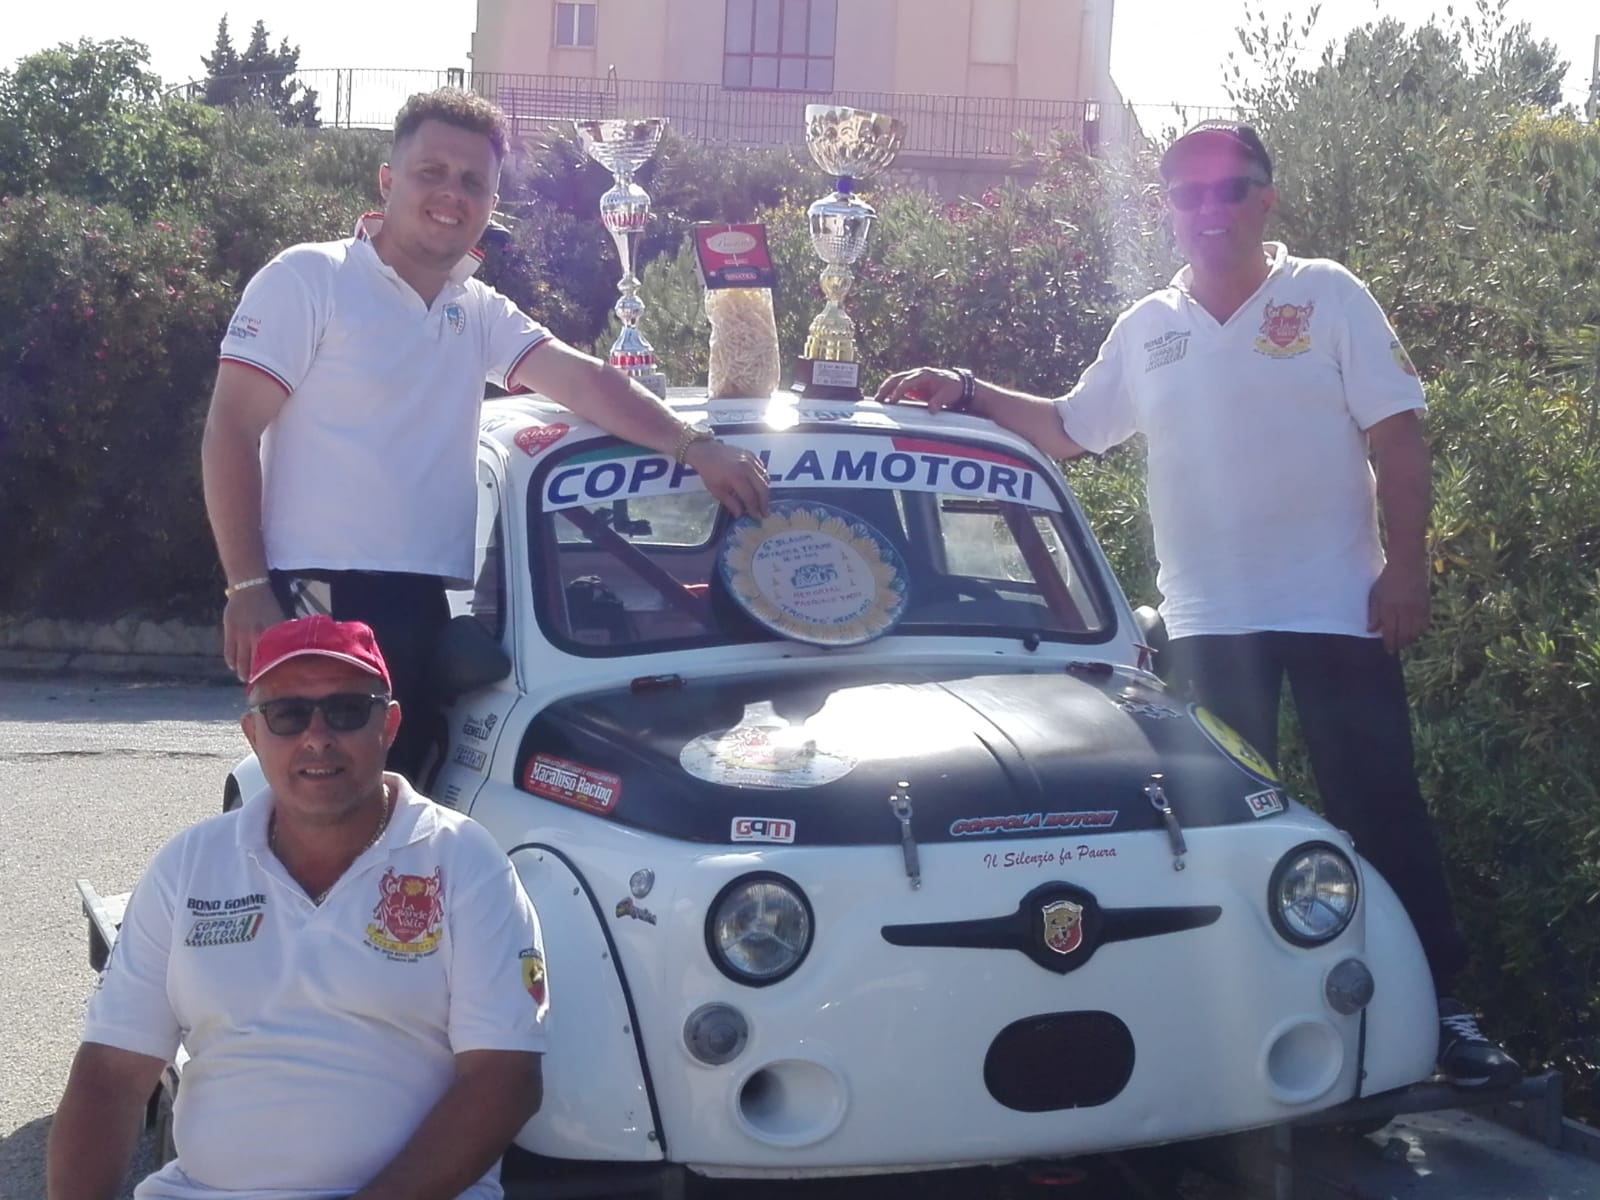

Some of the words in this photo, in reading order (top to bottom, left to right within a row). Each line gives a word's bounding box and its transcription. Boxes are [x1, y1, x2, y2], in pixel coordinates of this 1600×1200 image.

[547, 449, 1033, 504] COPPLAMOTORI
[530, 762, 578, 791] Macaluso
[576, 775, 613, 805] Racing
[951, 813, 1041, 836] COPPOLA
[1043, 811, 1118, 829] MOTORI
[984, 854, 998, 869] Il
[1003, 852, 1055, 868] Silenzio
[1060, 848, 1073, 866] fa
[1076, 845, 1117, 859] Paura
[187, 898, 221, 911] BONO
[224, 893, 268, 909] GOMME
[193, 927, 243, 940] MOTORI
[195, 917, 246, 931] COPPOLA
